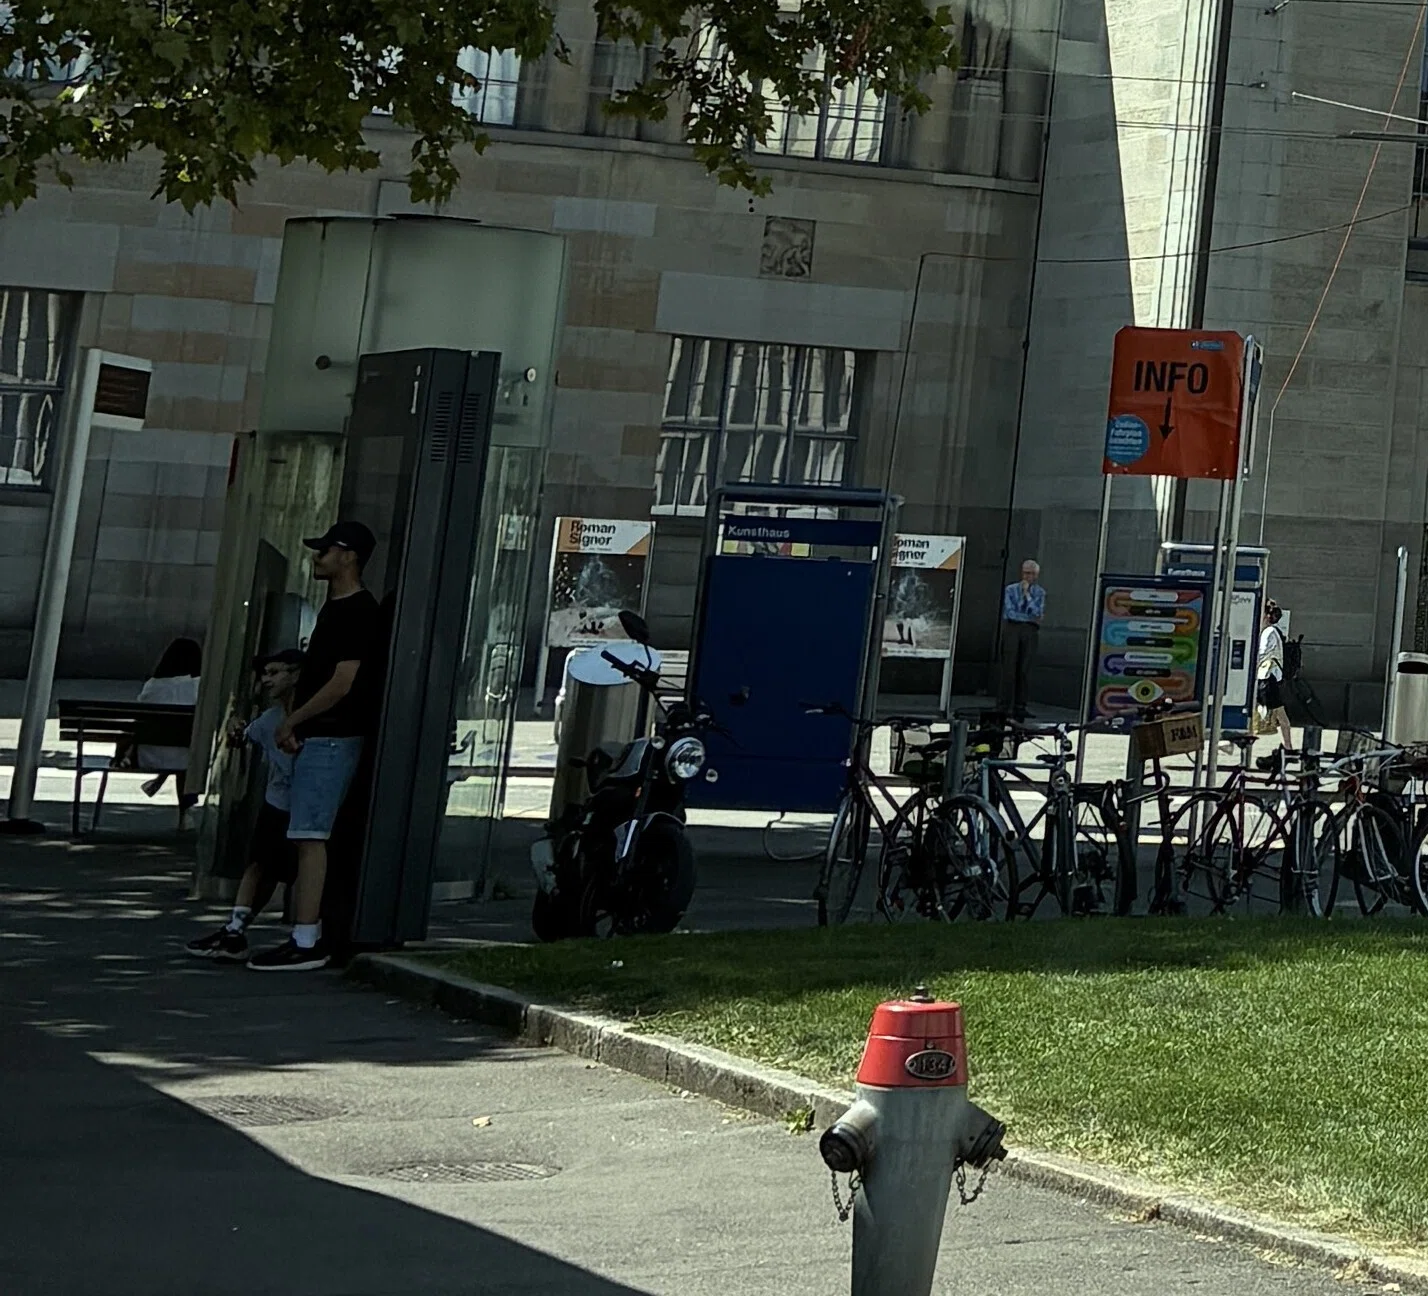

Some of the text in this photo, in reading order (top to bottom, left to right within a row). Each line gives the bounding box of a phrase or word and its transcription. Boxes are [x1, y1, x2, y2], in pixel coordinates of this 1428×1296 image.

[1134, 360, 1209, 394] INFO
[571, 520, 617, 534] Roman
[728, 524, 790, 539] Kunsthaus
